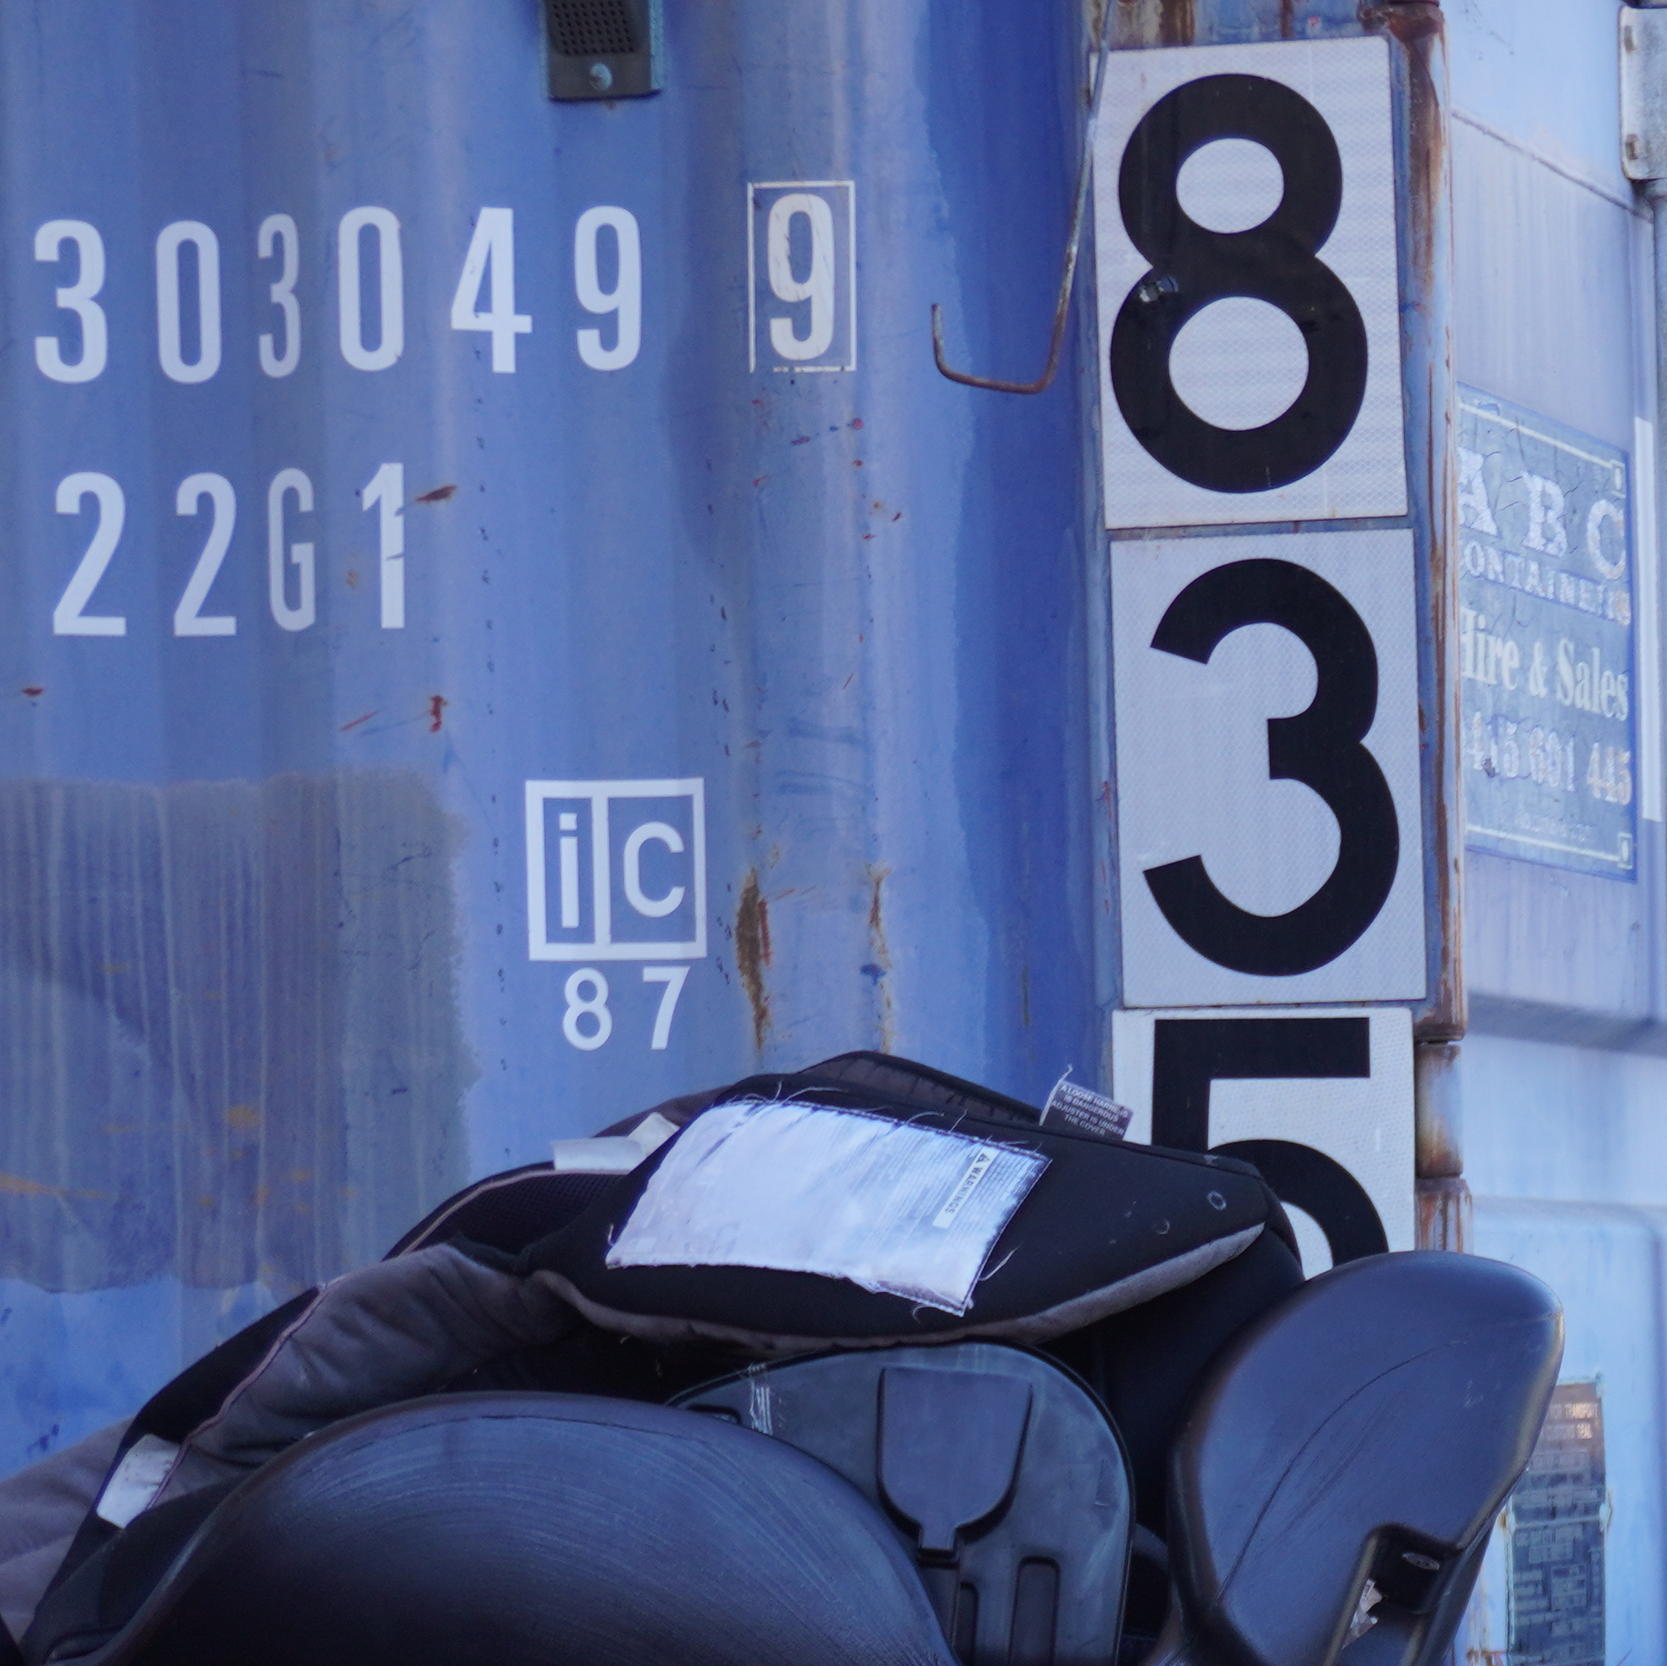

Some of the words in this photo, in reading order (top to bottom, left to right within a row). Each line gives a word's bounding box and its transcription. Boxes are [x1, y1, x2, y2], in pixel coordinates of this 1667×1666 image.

[34, 206, 642, 384] 303049
[766, 193, 836, 361] 9
[1110, 73, 1368, 494] 8
[53, 463, 405, 637] 22G1
[1144, 558, 1399, 977] 3
[1555, 636, 1630, 722] Sales
[562, 965, 690, 1051] 87
[1152, 1016, 1389, 1268] 5
